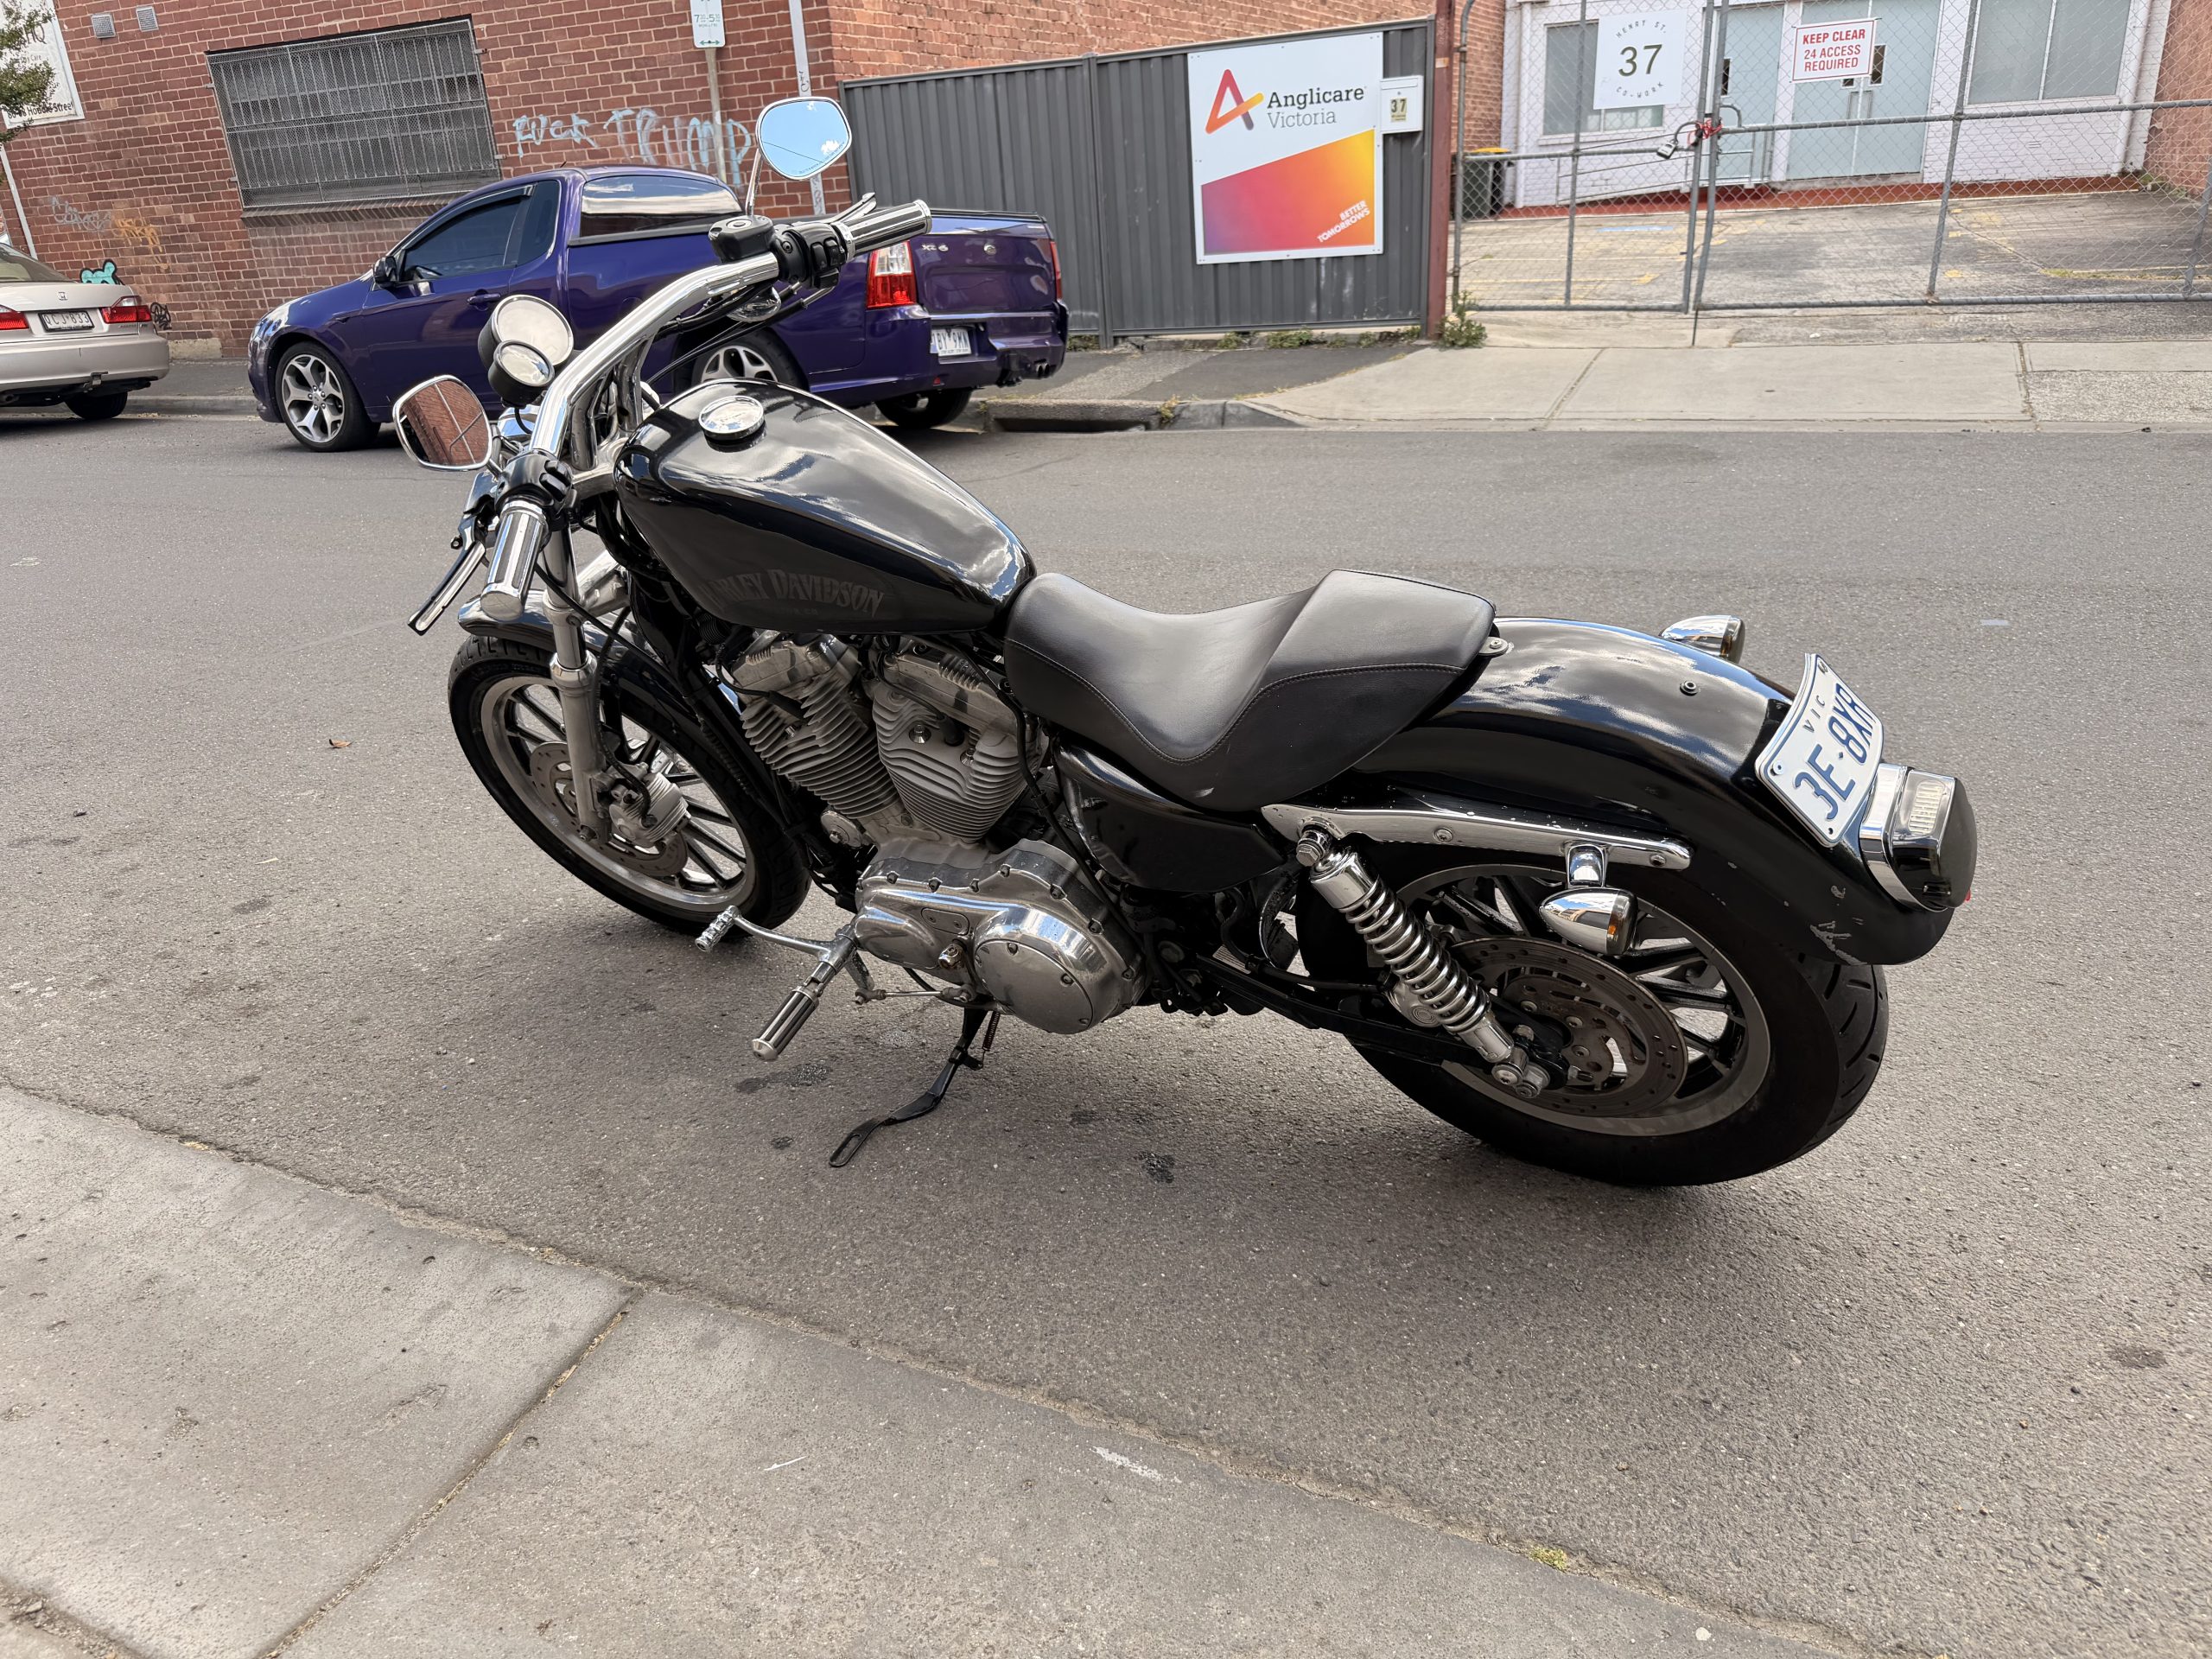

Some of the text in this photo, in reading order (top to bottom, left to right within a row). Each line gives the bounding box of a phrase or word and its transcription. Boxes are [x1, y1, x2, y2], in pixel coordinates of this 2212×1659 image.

[1616, 20, 1646, 38] HENRY
[1802, 29, 1866, 45] KEEP CLEAR
[1618, 44, 1662, 77] 37
[1804, 44, 1861, 60] 24 ACCESS
[1804, 57, 1859, 73] REQUIRED
[1267, 87, 1364, 110] Anglicare
[1616, 81, 1664, 99] CO-WORK
[1390, 99, 1407, 113] 37
[1268, 109, 1337, 129] Victoria
[602, 108, 752, 188] TRUMP
[1339, 200, 1368, 220] BETTER
[1317, 207, 1370, 242] TOMORROWS
[766, 569, 886, 618] DAVIDSON
[1803, 695, 1826, 734] VIC
